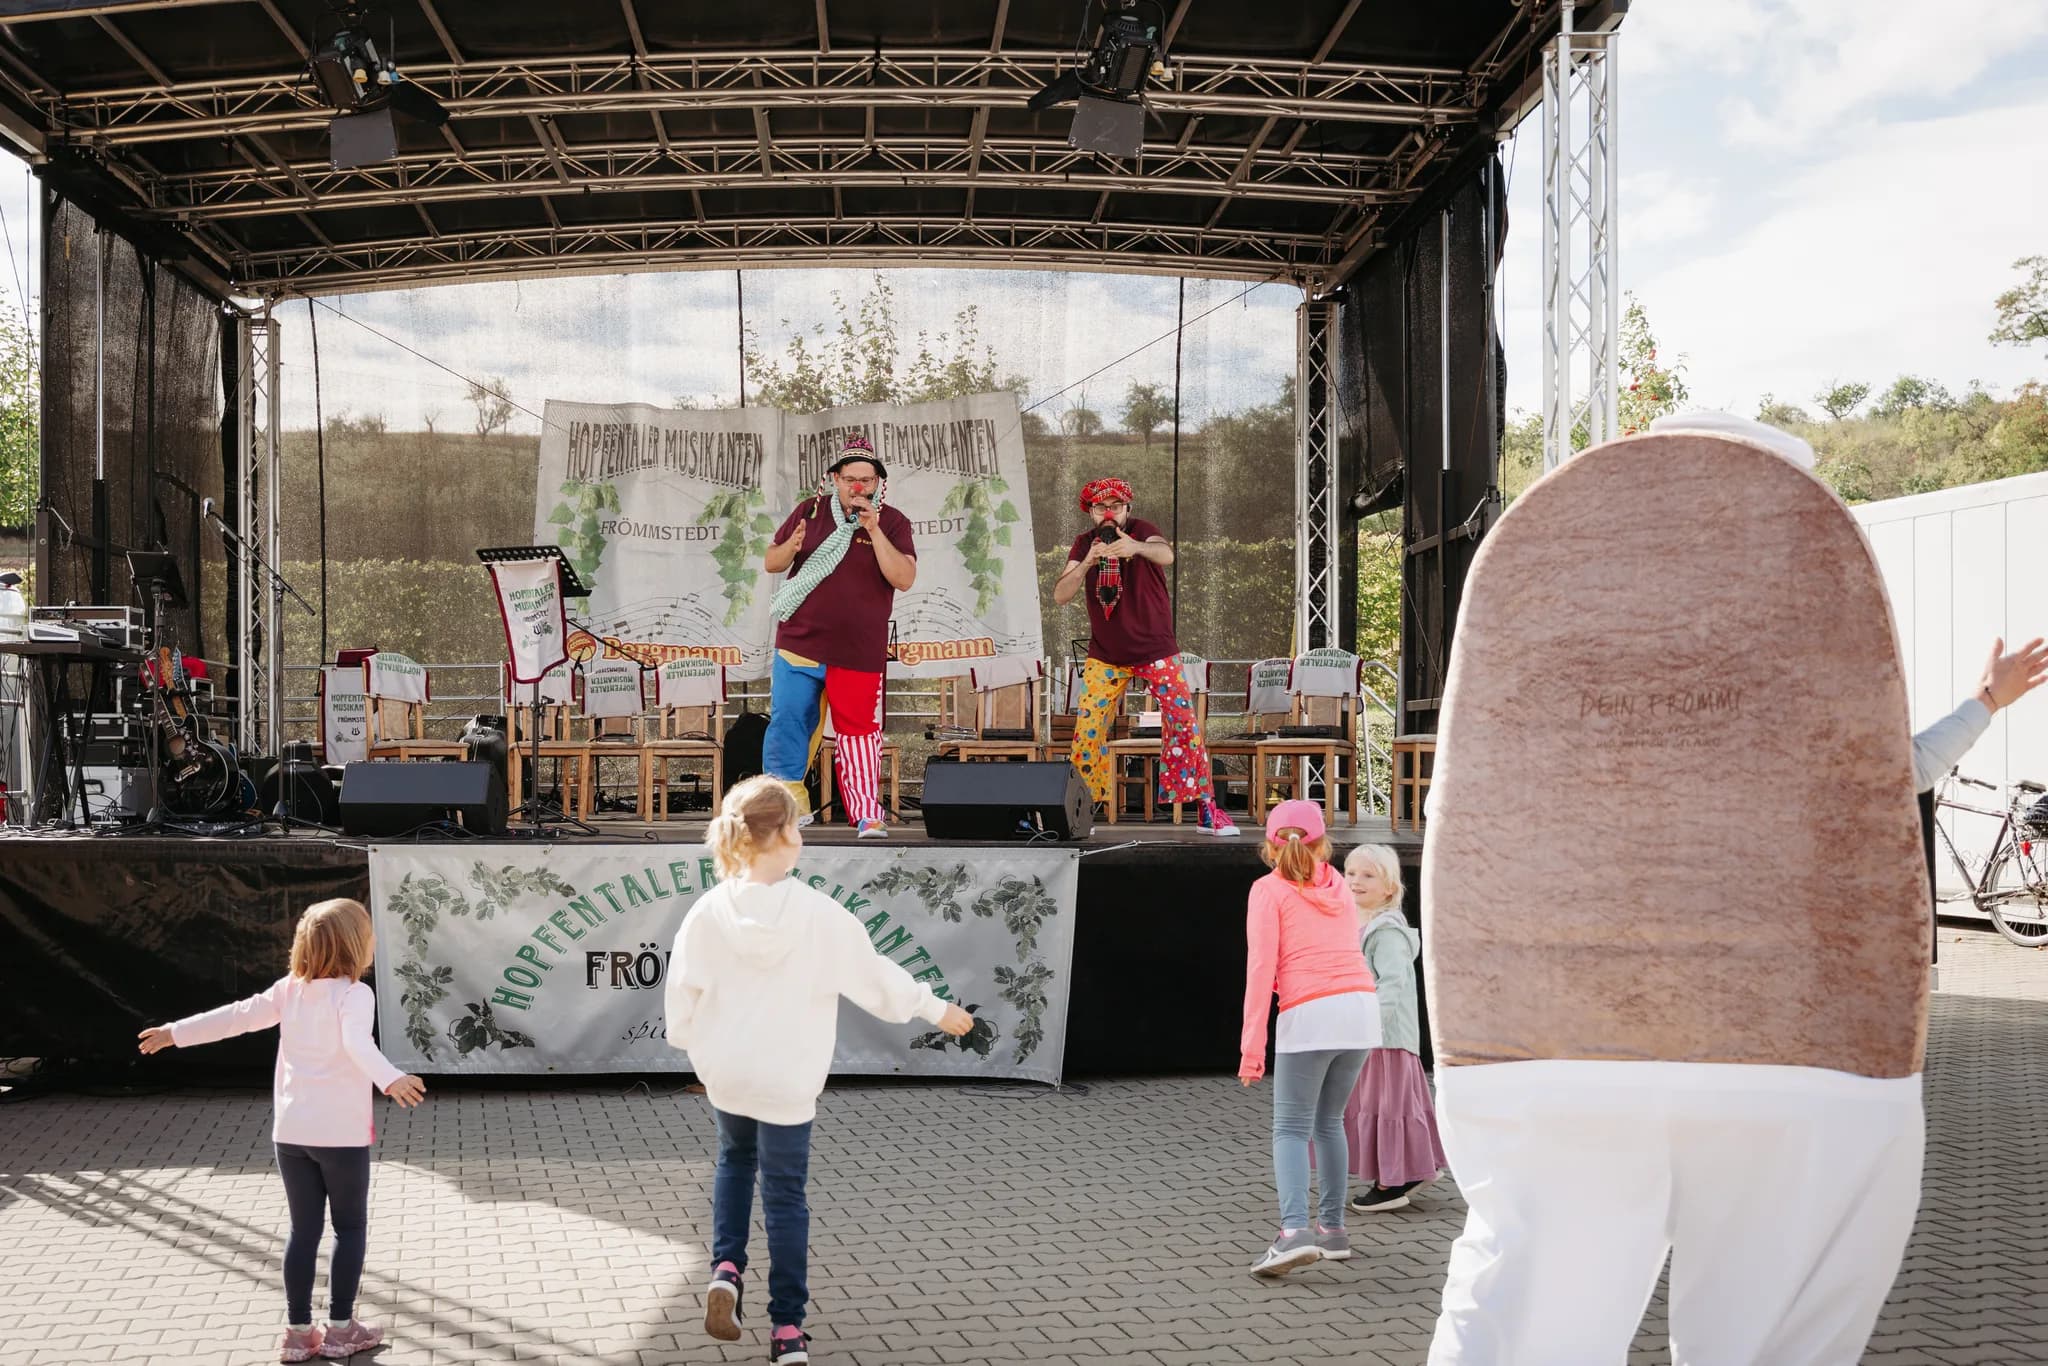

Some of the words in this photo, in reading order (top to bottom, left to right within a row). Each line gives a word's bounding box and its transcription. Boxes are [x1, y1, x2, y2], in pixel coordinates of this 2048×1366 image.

[566, 420, 660, 485] HOPFENTALER
[664, 427, 764, 491] MUSIKANTEN
[896, 418, 1001, 480] MUSIKANTEN
[600, 517, 720, 542] FRÖMMSTEDT
[602, 636, 742, 668] Bergmann
[1300, 657, 1351, 669] HOPFENTALER
[591, 674, 634, 686] MUSIKANTEN
[666, 668, 716, 680] HOPFENTALER
[590, 683, 636, 694] HOPFENTALER
[1580, 692, 1634, 720] DEIN
[491, 857, 718, 1010] HOPFENTALER
[586, 942, 671, 990] FRÖ
